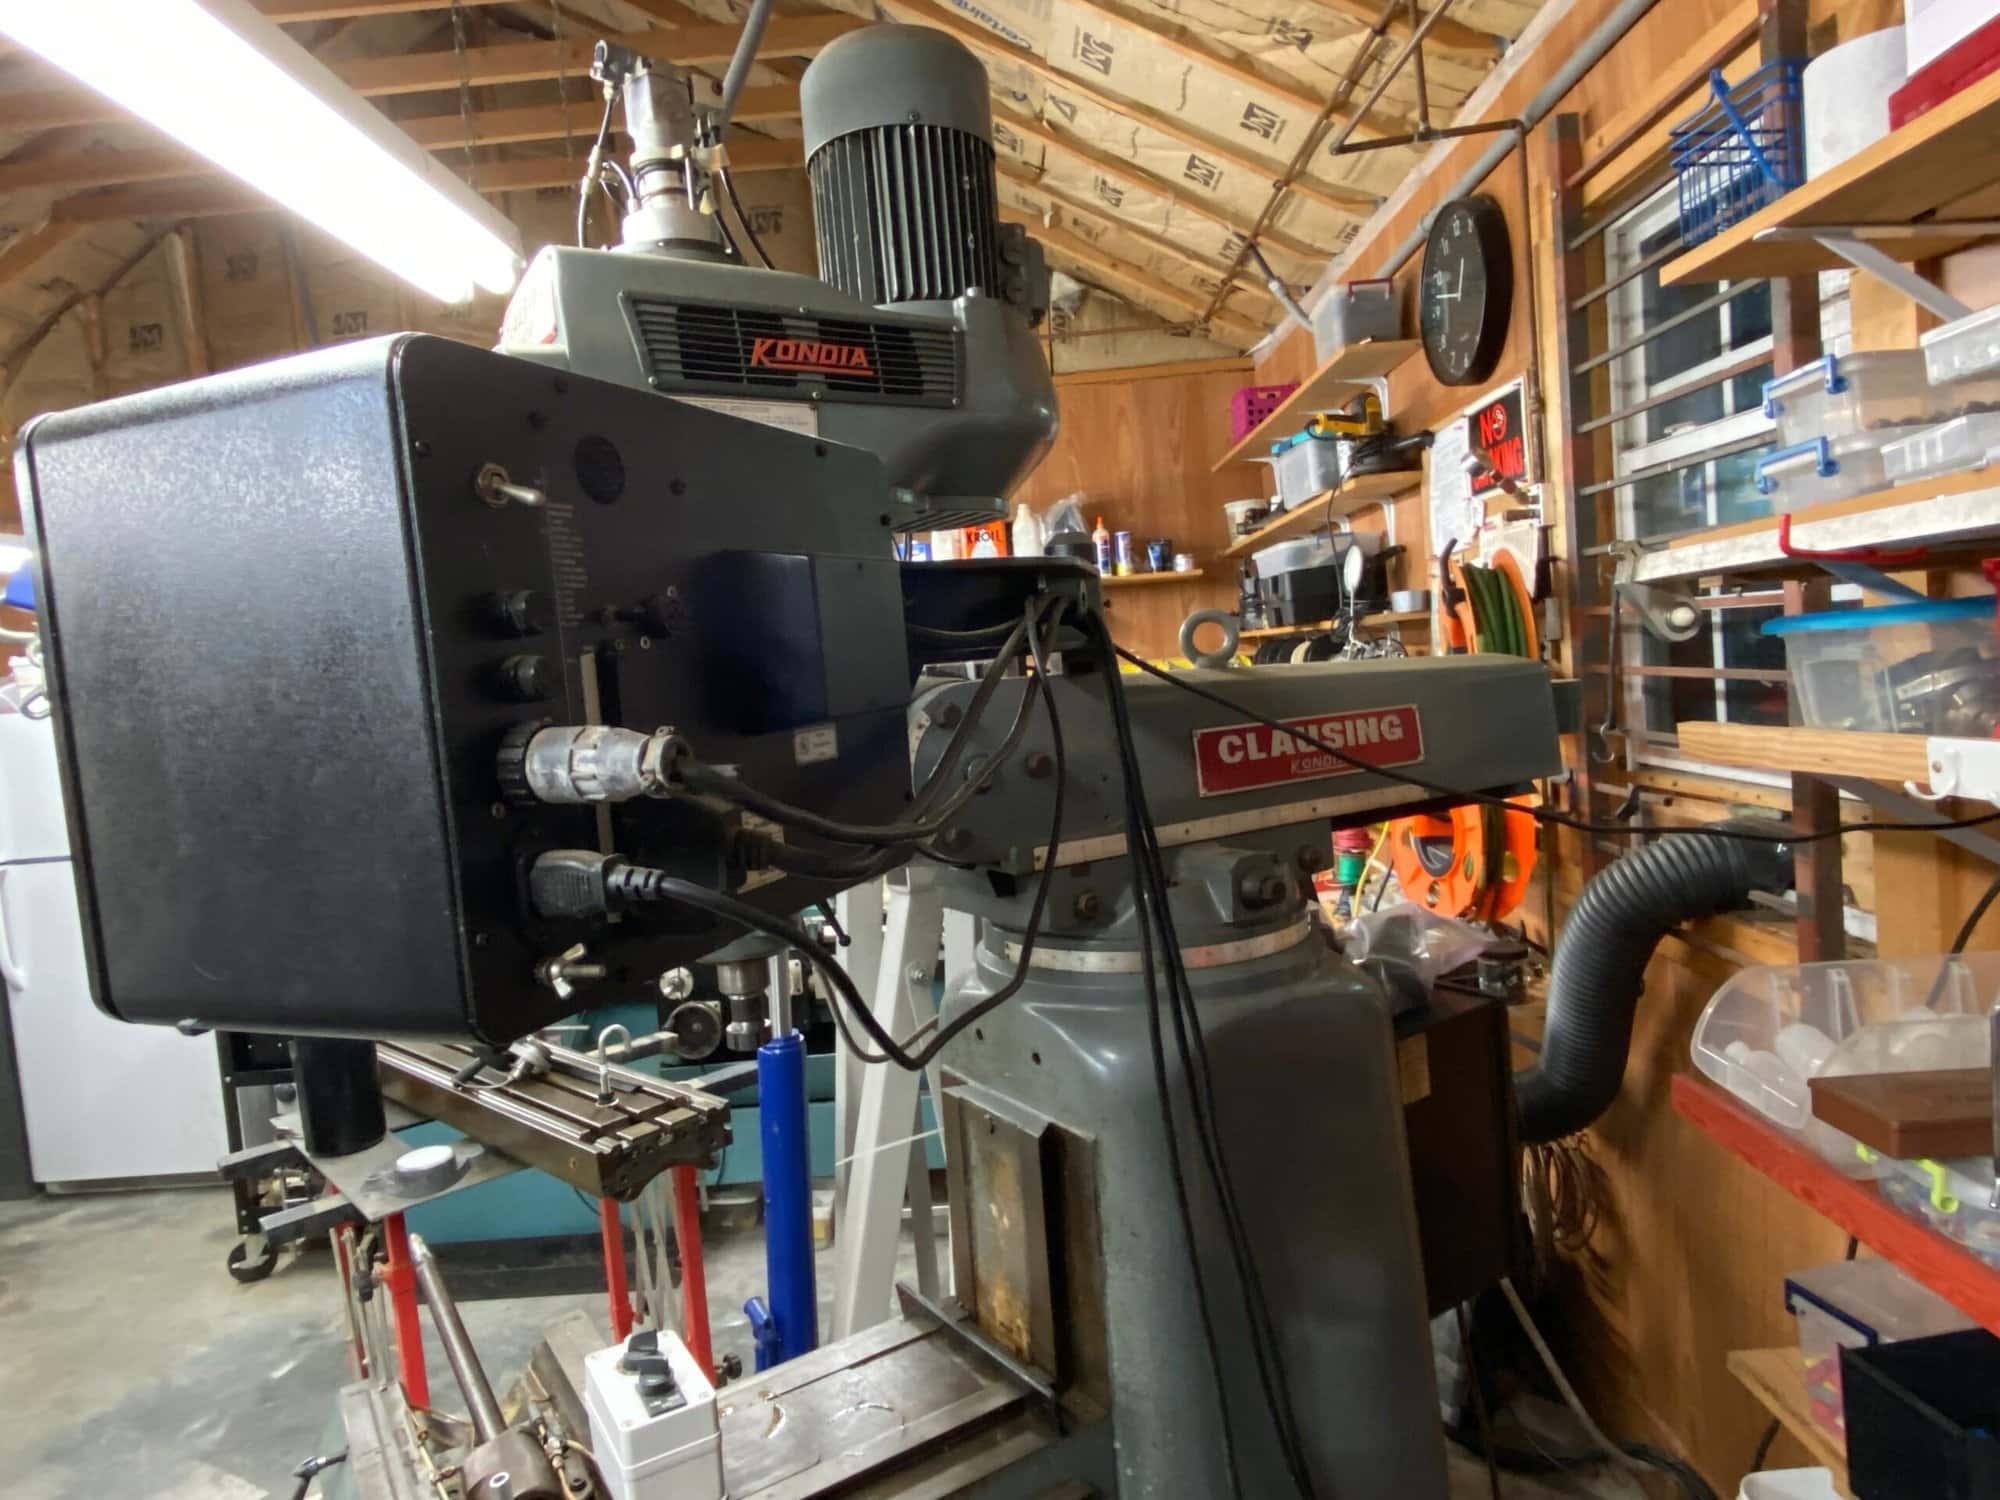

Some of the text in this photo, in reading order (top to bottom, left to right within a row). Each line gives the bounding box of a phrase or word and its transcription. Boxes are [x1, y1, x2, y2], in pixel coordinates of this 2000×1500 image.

[750, 338, 870, 369] KONDIA
[1479, 402, 1507, 449] NO
[1217, 714, 1405, 765] CLAUSING
